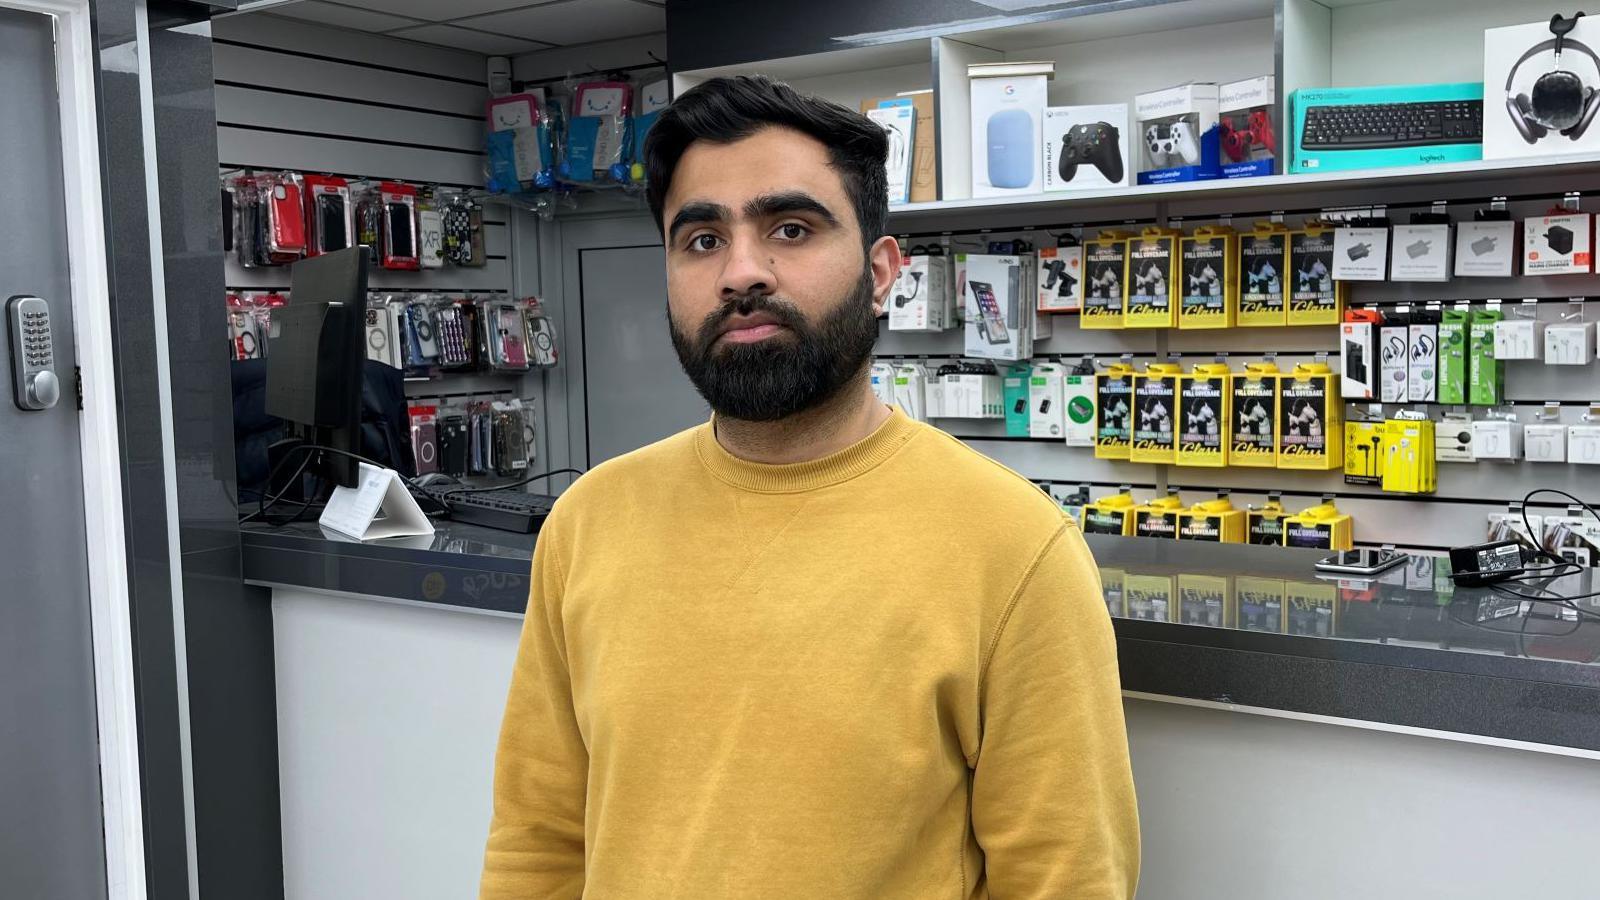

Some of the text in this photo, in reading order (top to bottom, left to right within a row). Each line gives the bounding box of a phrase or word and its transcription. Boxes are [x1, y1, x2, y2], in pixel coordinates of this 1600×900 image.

[1236, 89, 1262, 100] Controller
[1160, 98, 1185, 108] Controller
[1420, 154, 1445, 164] logitech
[424, 231, 440, 249] XR
[1301, 530, 1329, 538] COVERAGE
